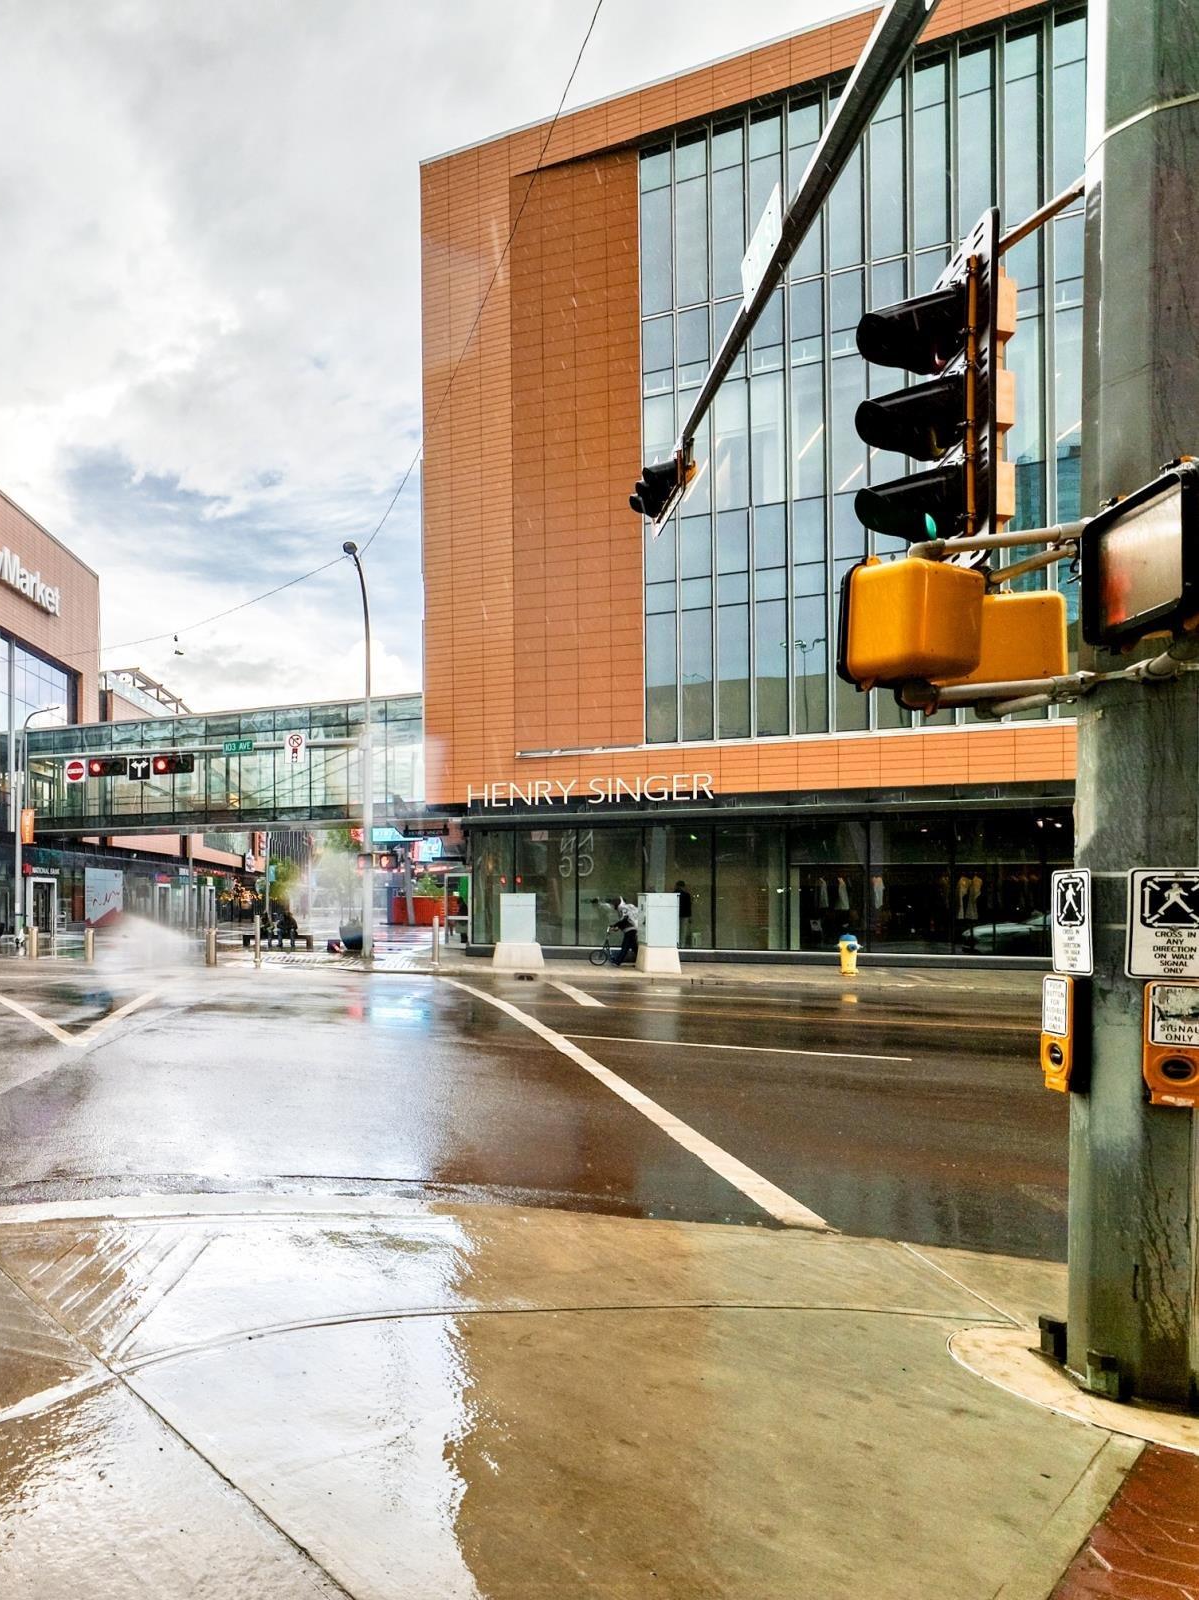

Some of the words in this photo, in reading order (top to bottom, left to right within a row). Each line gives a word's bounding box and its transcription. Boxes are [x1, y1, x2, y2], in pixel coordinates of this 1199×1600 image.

[225, 743, 236, 751] 103
[238, 742, 251, 750] AVE
[466, 779, 578, 808] HENRY
[588, 773, 714, 804] SINGER
[1155, 930, 1182, 938] CROSS
[1152, 945, 1197, 953] DIRECTION
[1160, 1024, 1199, 1033] SIGNAL
[1165, 1033, 1193, 1042] ONLY
